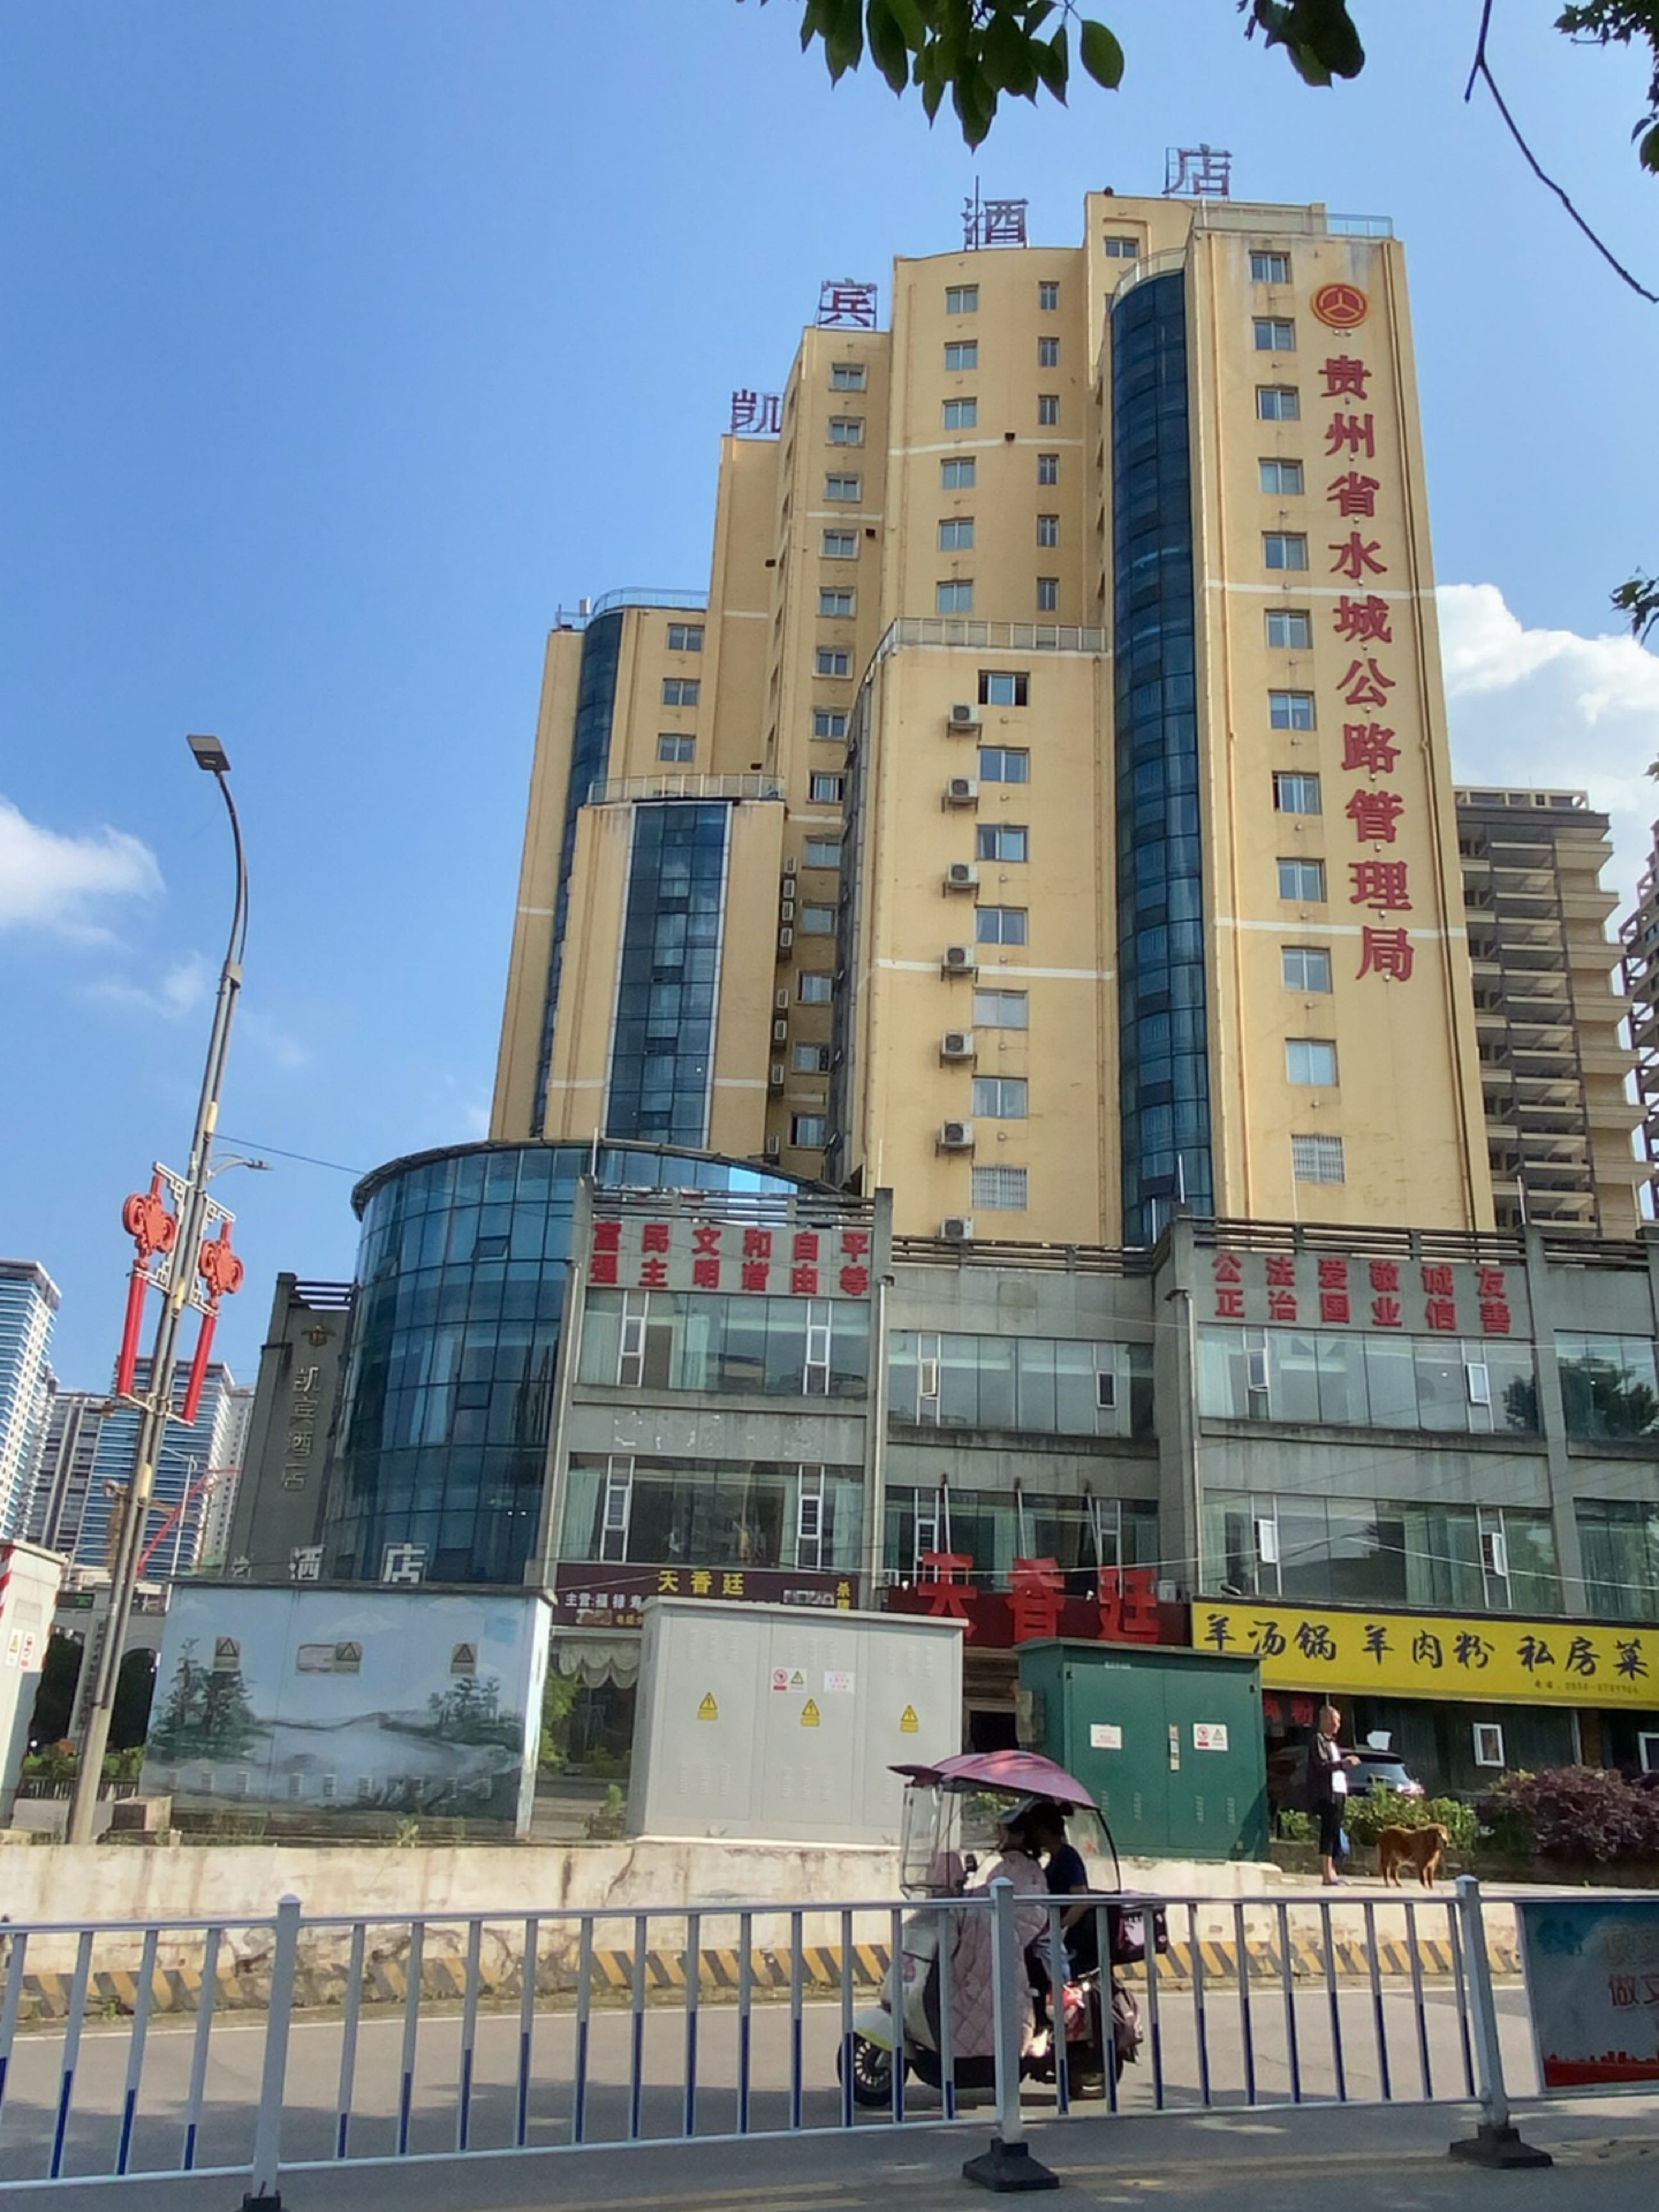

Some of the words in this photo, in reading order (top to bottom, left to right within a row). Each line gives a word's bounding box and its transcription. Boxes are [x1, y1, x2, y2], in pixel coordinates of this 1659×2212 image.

[1318, 355, 1414, 982] 贵州省水城公路管理局
[1204, 1613, 1336, 1660] 羊汤锅
[1362, 1624, 1495, 1669] 羊肉粉
[1517, 1634, 1650, 1681] 私房菜
